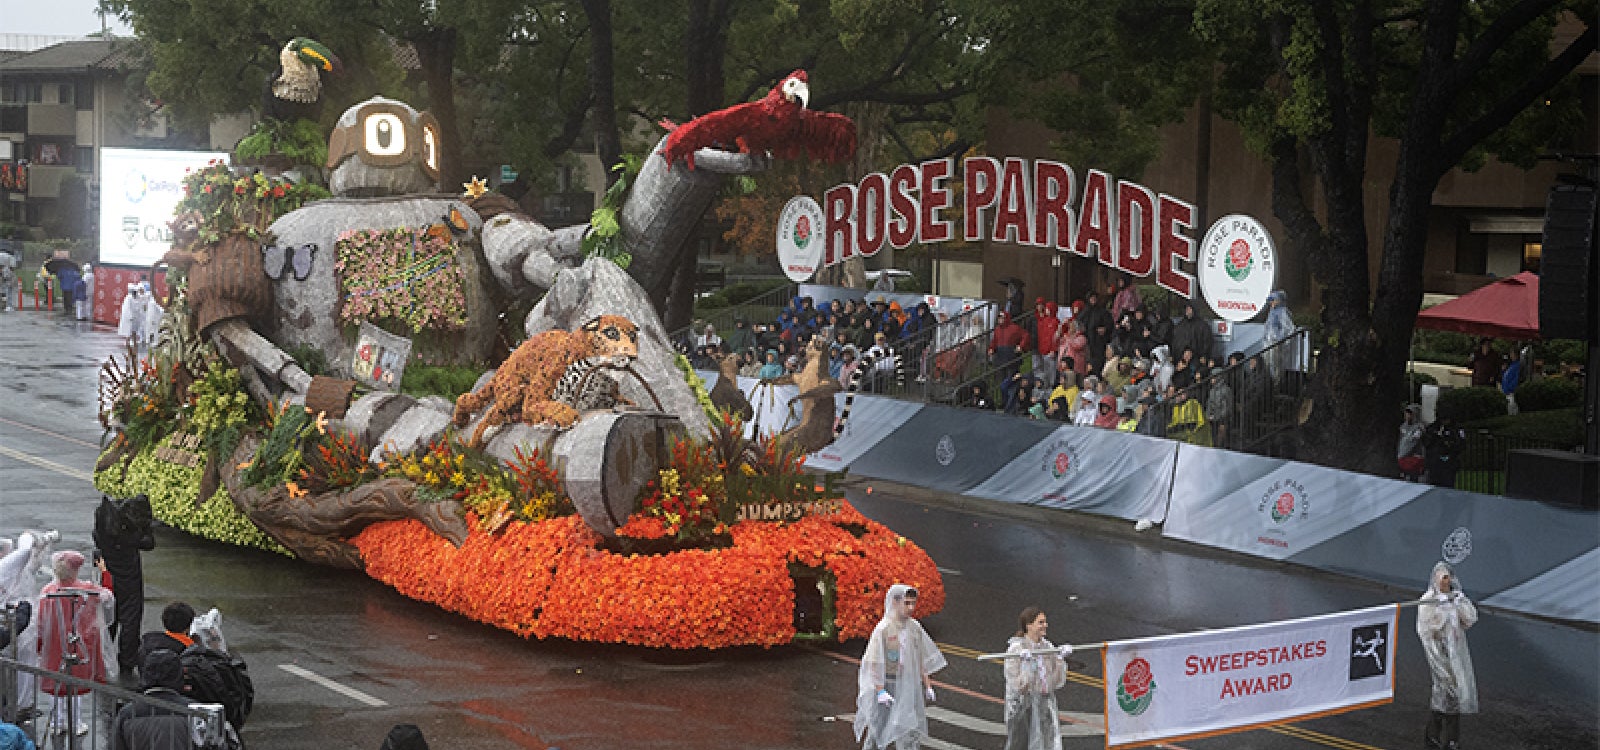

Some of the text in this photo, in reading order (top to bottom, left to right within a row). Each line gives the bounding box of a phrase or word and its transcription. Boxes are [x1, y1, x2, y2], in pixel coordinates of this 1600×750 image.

[823, 157, 1198, 299] ROSE PARADE
[1207, 220, 1271, 271] ROSE PARADE
[1217, 299, 1257, 312] HONDA
[1257, 478, 1309, 520] ROSE PARADE
[1185, 639, 1327, 676] SWEEPSTAKES
[1219, 672, 1293, 700] AWARD
